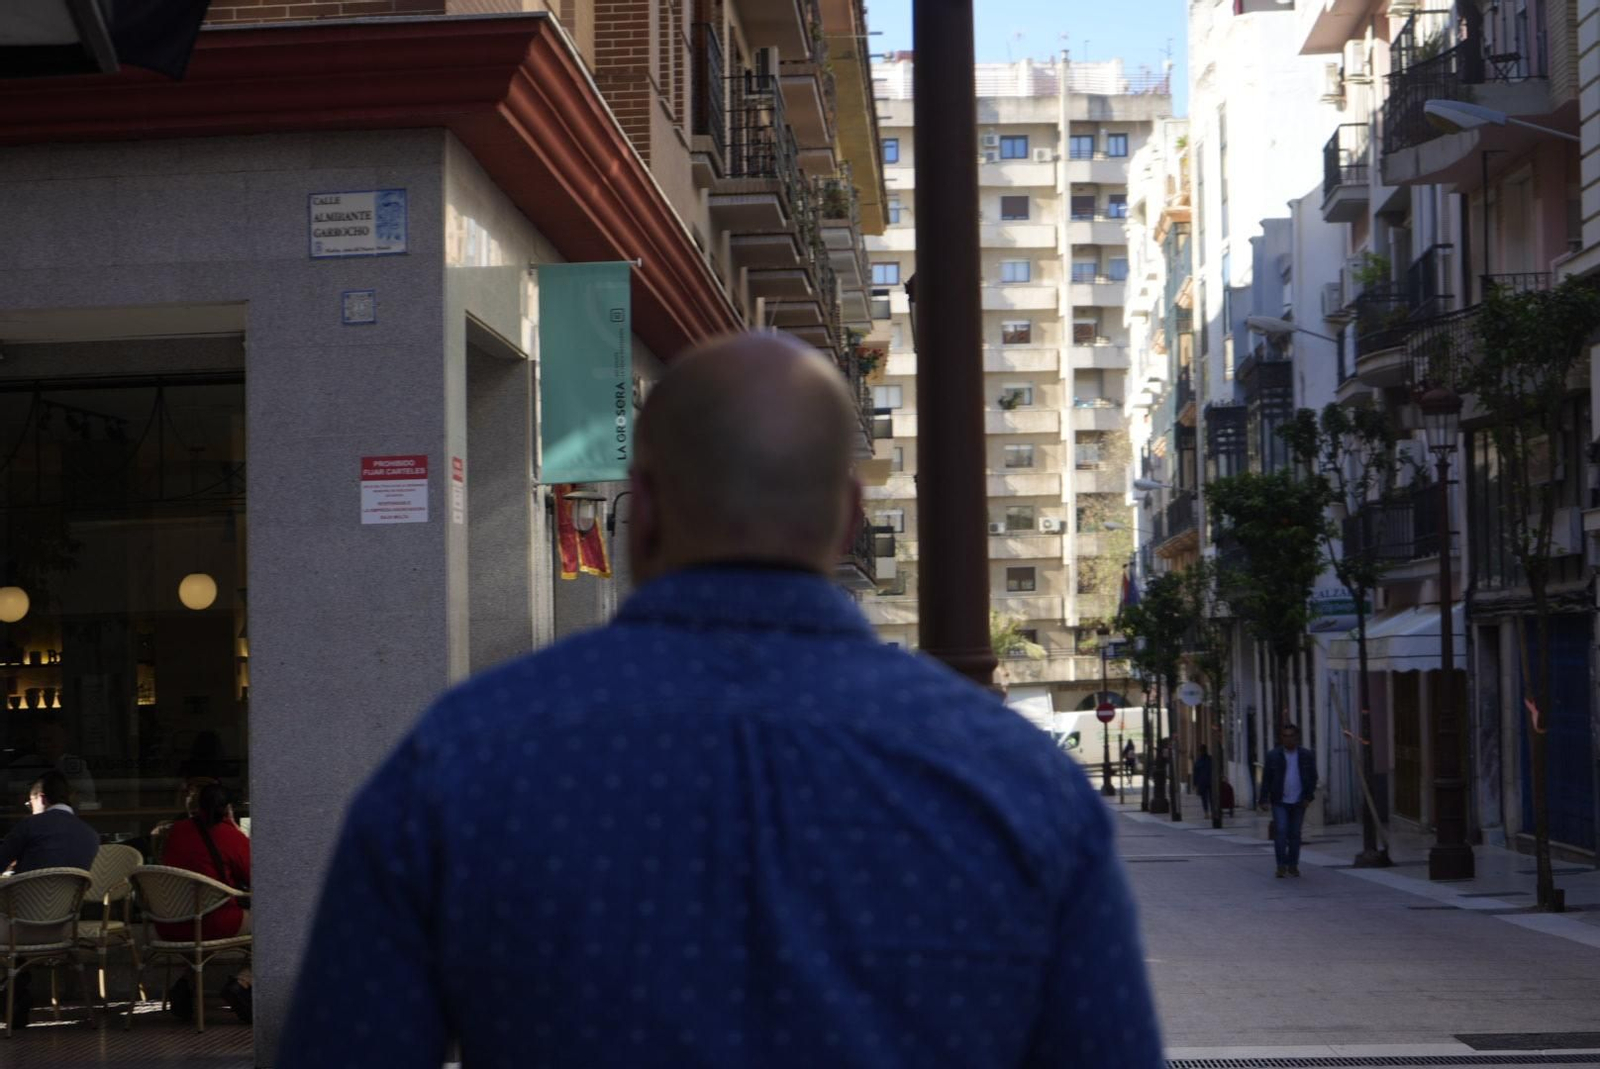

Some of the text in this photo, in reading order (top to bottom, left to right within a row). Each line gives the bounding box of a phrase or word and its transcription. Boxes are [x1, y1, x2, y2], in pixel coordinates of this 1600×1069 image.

[313, 196, 341, 206] CALLE
[313, 210, 372, 222] ALMIRANTE
[313, 226, 370, 238] GARROCHO
[617, 445, 627, 460] LA
[373, 459, 415, 467] PROHIBIDO
[387, 467, 425, 475] CARTELES
